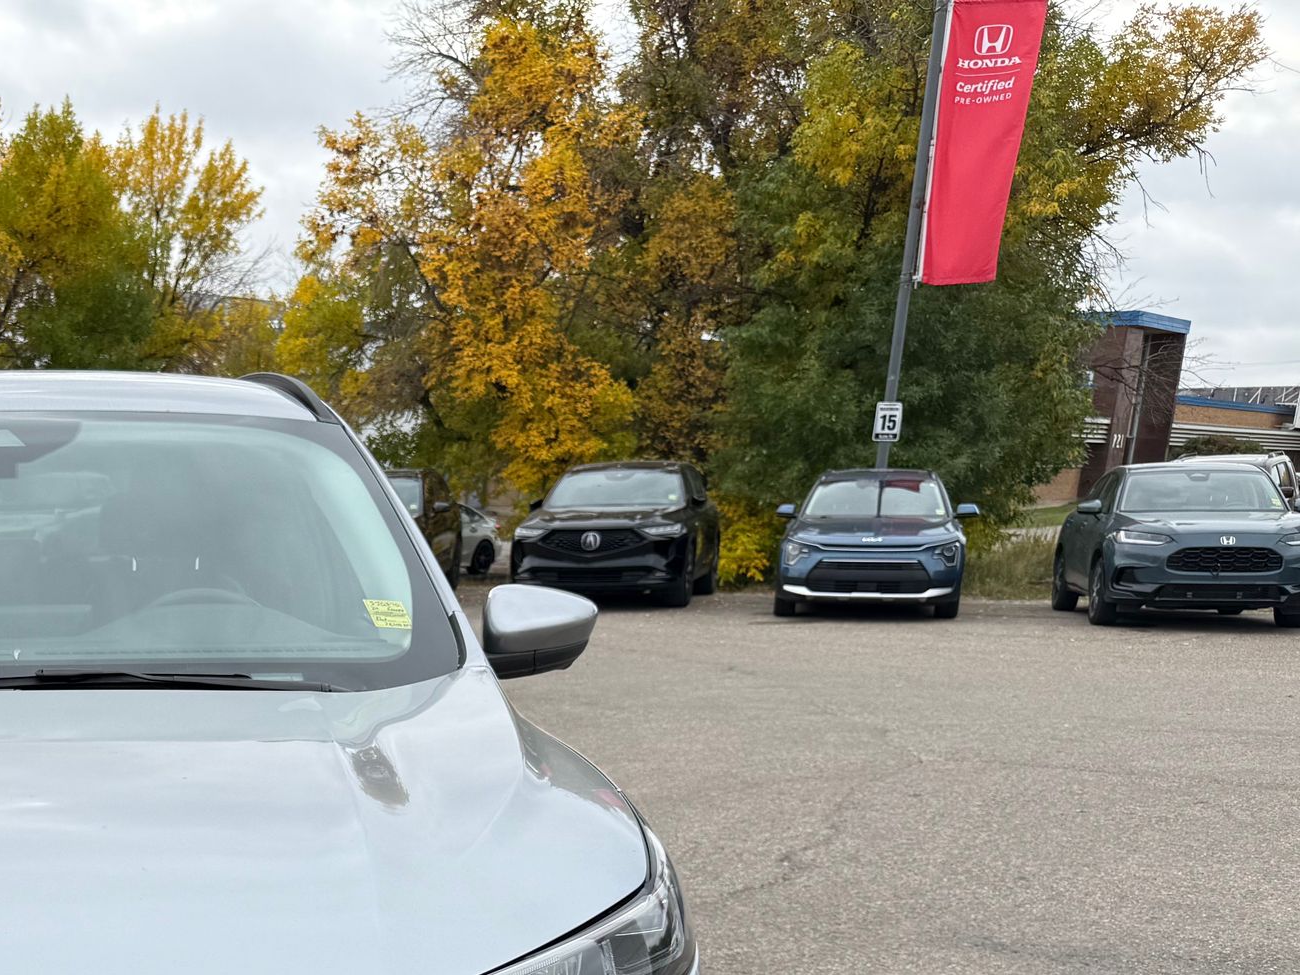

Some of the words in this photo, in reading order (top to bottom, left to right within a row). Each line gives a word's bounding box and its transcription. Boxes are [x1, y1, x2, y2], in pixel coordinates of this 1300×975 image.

[957, 56, 1022, 69] HONDA
[956, 76, 1015, 94] Certified
[954, 92, 1012, 105] PRE-OWNED
[880, 414, 897, 431] 15
[1112, 433, 1125, 449] 721
